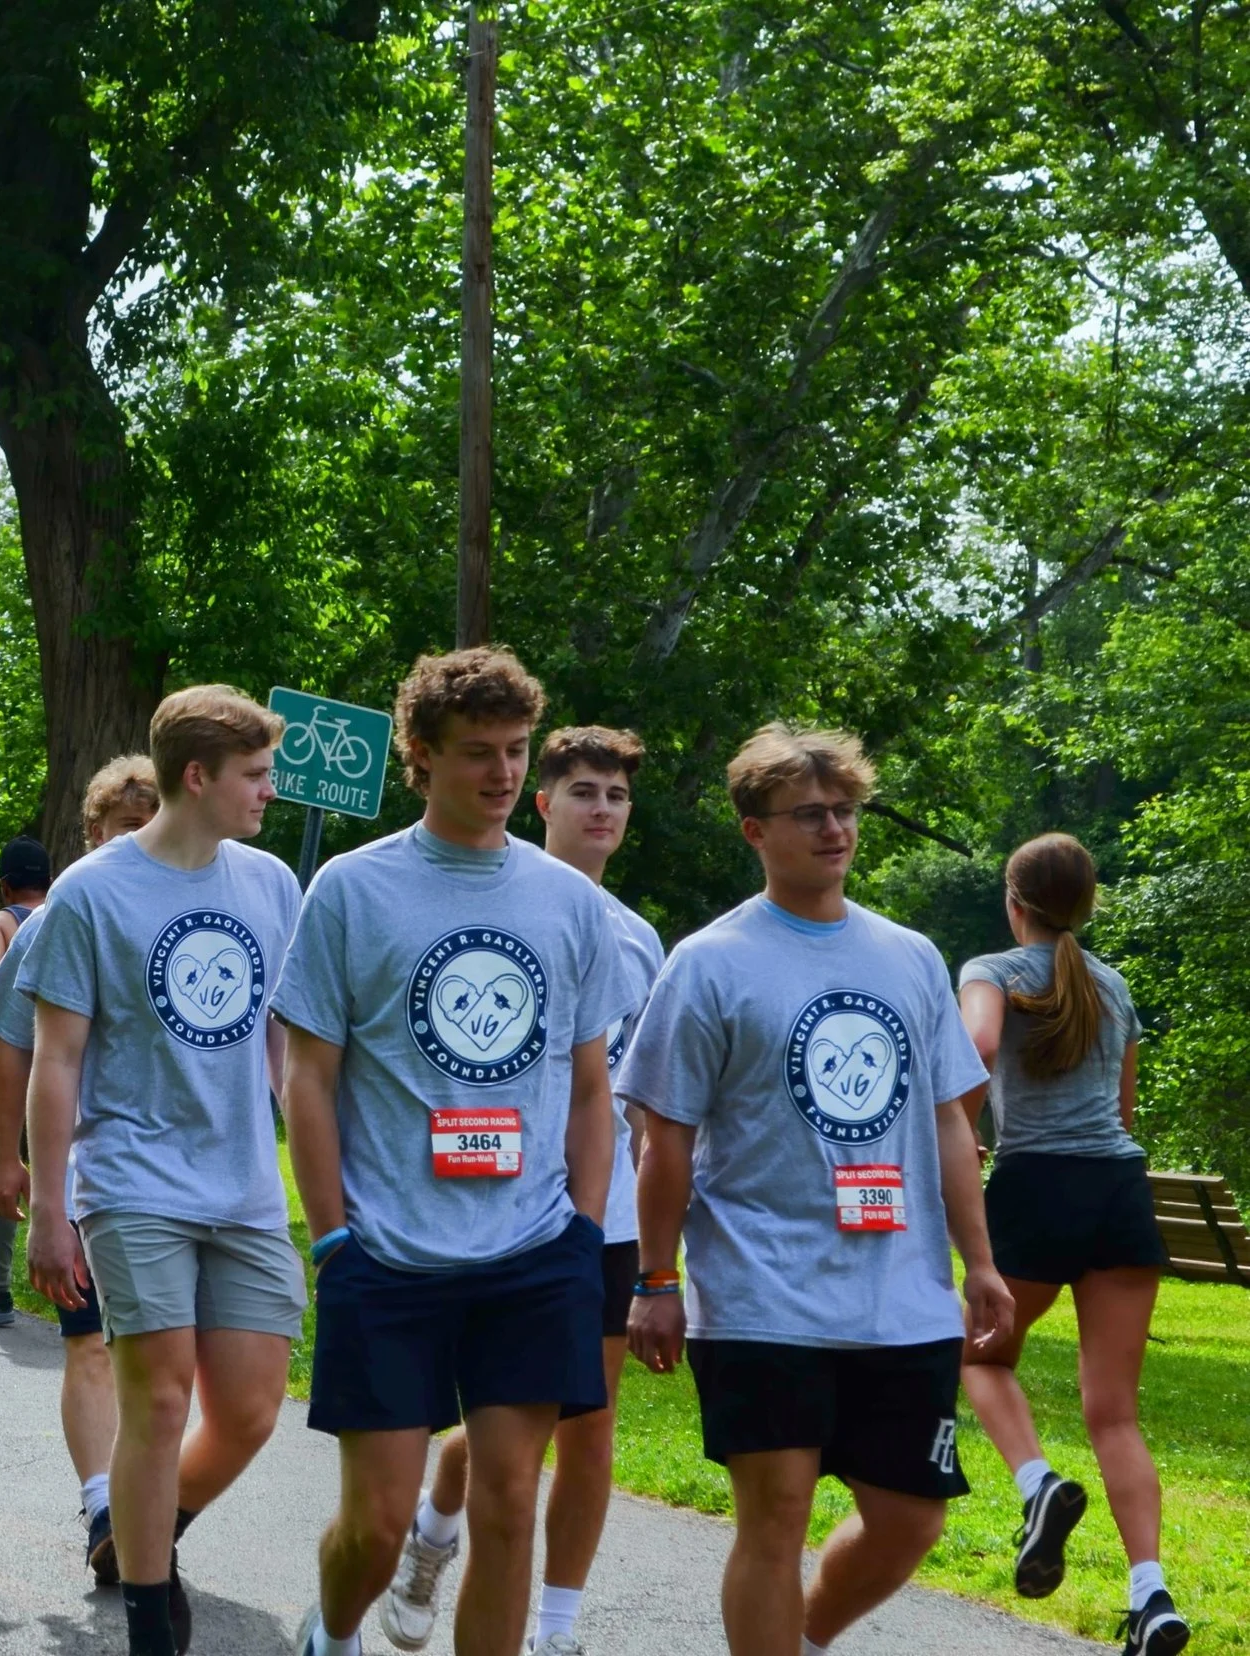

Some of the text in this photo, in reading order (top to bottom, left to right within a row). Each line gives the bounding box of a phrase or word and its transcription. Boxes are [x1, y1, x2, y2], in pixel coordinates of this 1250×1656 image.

[270, 769, 369, 810] BIKE ROUTE
[152, 915, 262, 986] VINCENT R. GAGLIARDI
[414, 942, 452, 1009] VINCENT
[459, 934, 474, 945] R.
[199, 985, 225, 1007] VG
[167, 1006, 257, 1044] FOUNDATION
[471, 1013, 500, 1038] VG
[790, 995, 907, 1074] VINCENT R. GAGLIARDI
[427, 1040, 542, 1079] FOUNDATION
[840, 1073, 870, 1097] VG
[437, 1117, 517, 1127] SPLIT SECOND RACING
[806, 1097, 903, 1138] FOUNDATION
[457, 1134, 502, 1151] 3464
[448, 1154, 495, 1163] Fun Run-Walk
[836, 1171, 856, 1180] SPLIT
[857, 1170, 885, 1179] SECOND
[858, 1188, 893, 1205] 3390
[863, 1210, 891, 1219] FUN RUN
